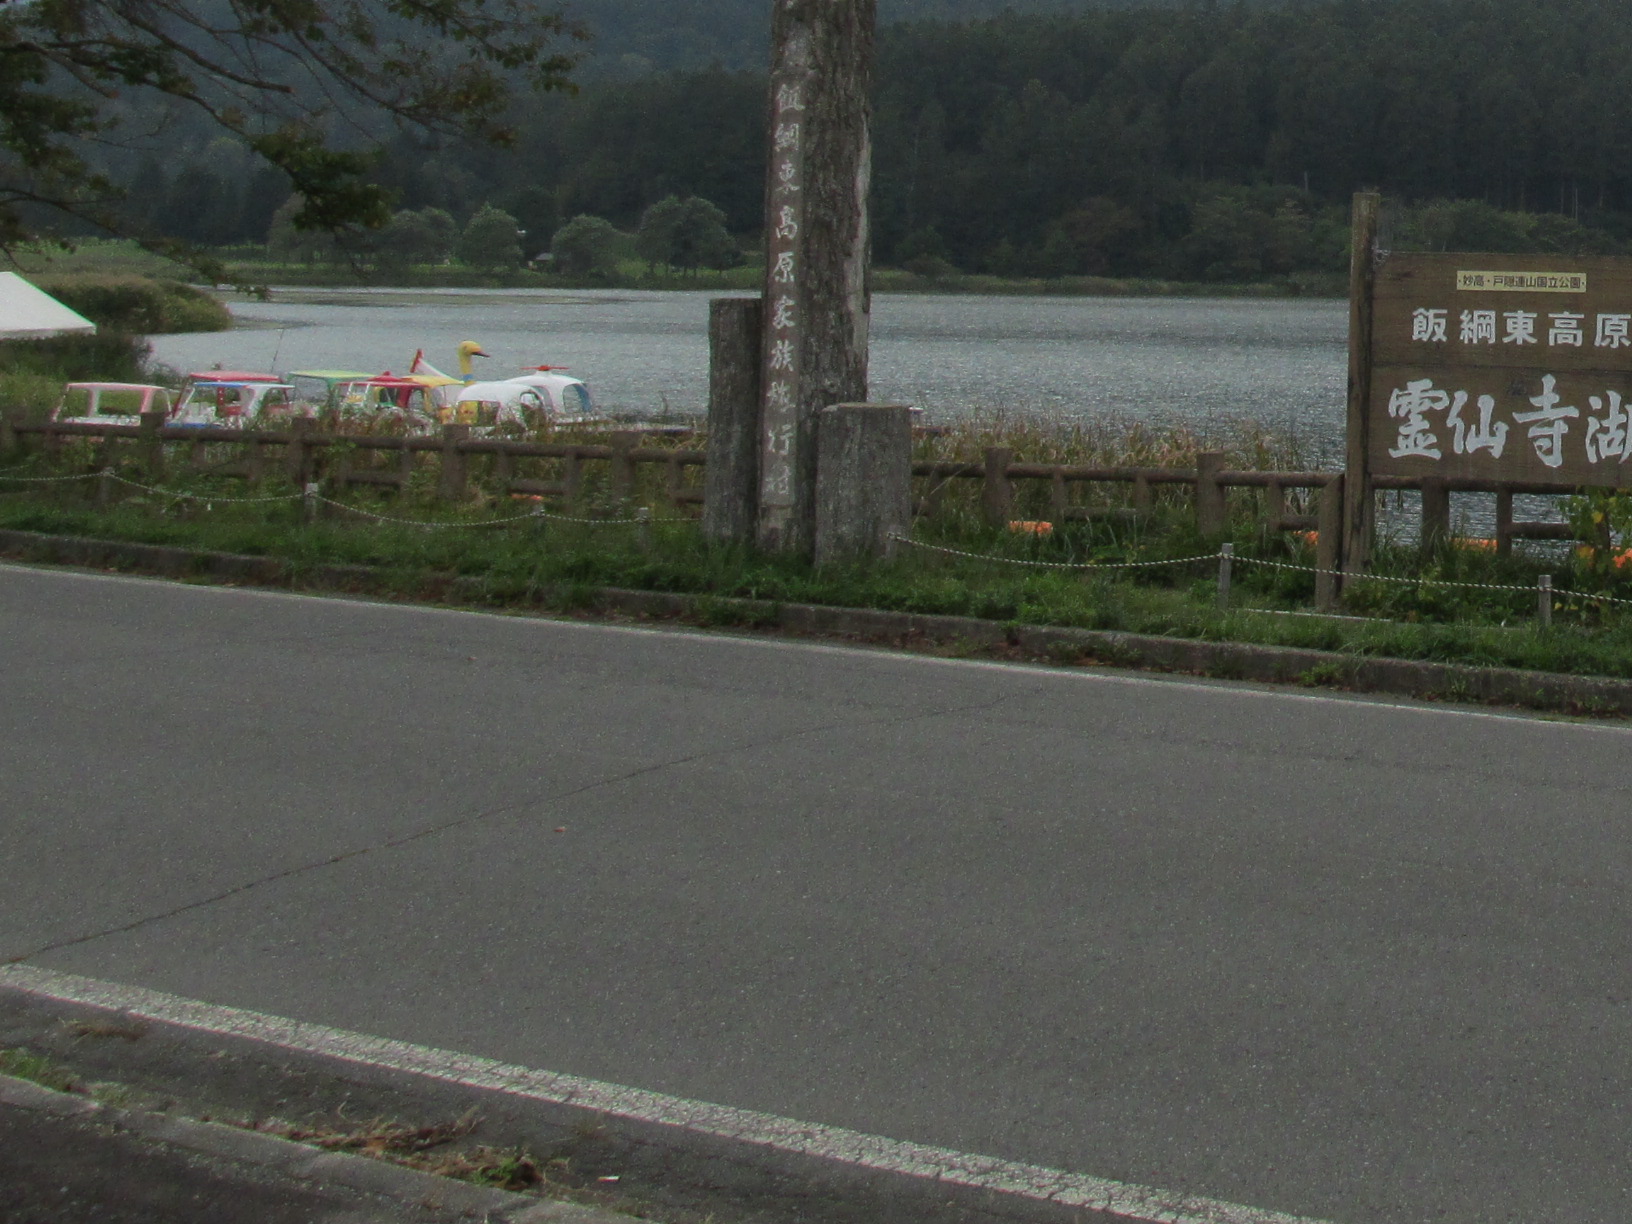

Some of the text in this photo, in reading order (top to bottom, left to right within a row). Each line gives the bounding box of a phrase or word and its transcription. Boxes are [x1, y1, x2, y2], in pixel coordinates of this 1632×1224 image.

[1411, 307, 1632, 349] 飯綱東高原
